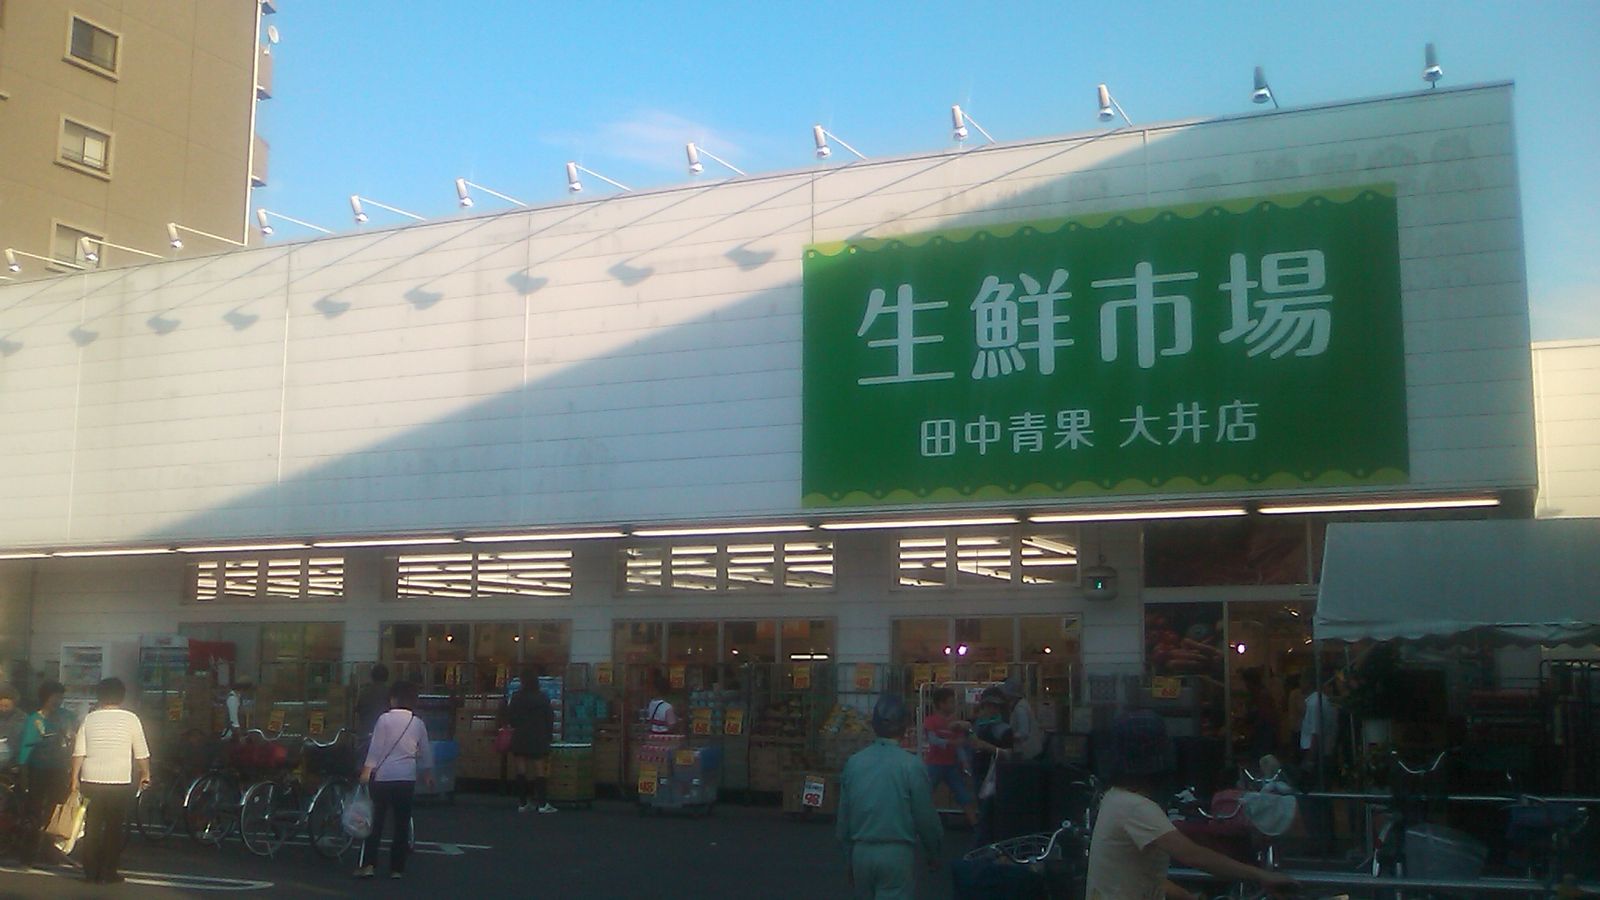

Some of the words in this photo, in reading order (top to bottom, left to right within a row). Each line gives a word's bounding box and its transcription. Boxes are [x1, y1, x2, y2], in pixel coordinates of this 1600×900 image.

[856, 248, 1334, 386] 生鮮市場
[920, 409, 1095, 457] 田中青果
[1119, 400, 1260, 448] 大井店
[805, 794, 819, 805] 98
